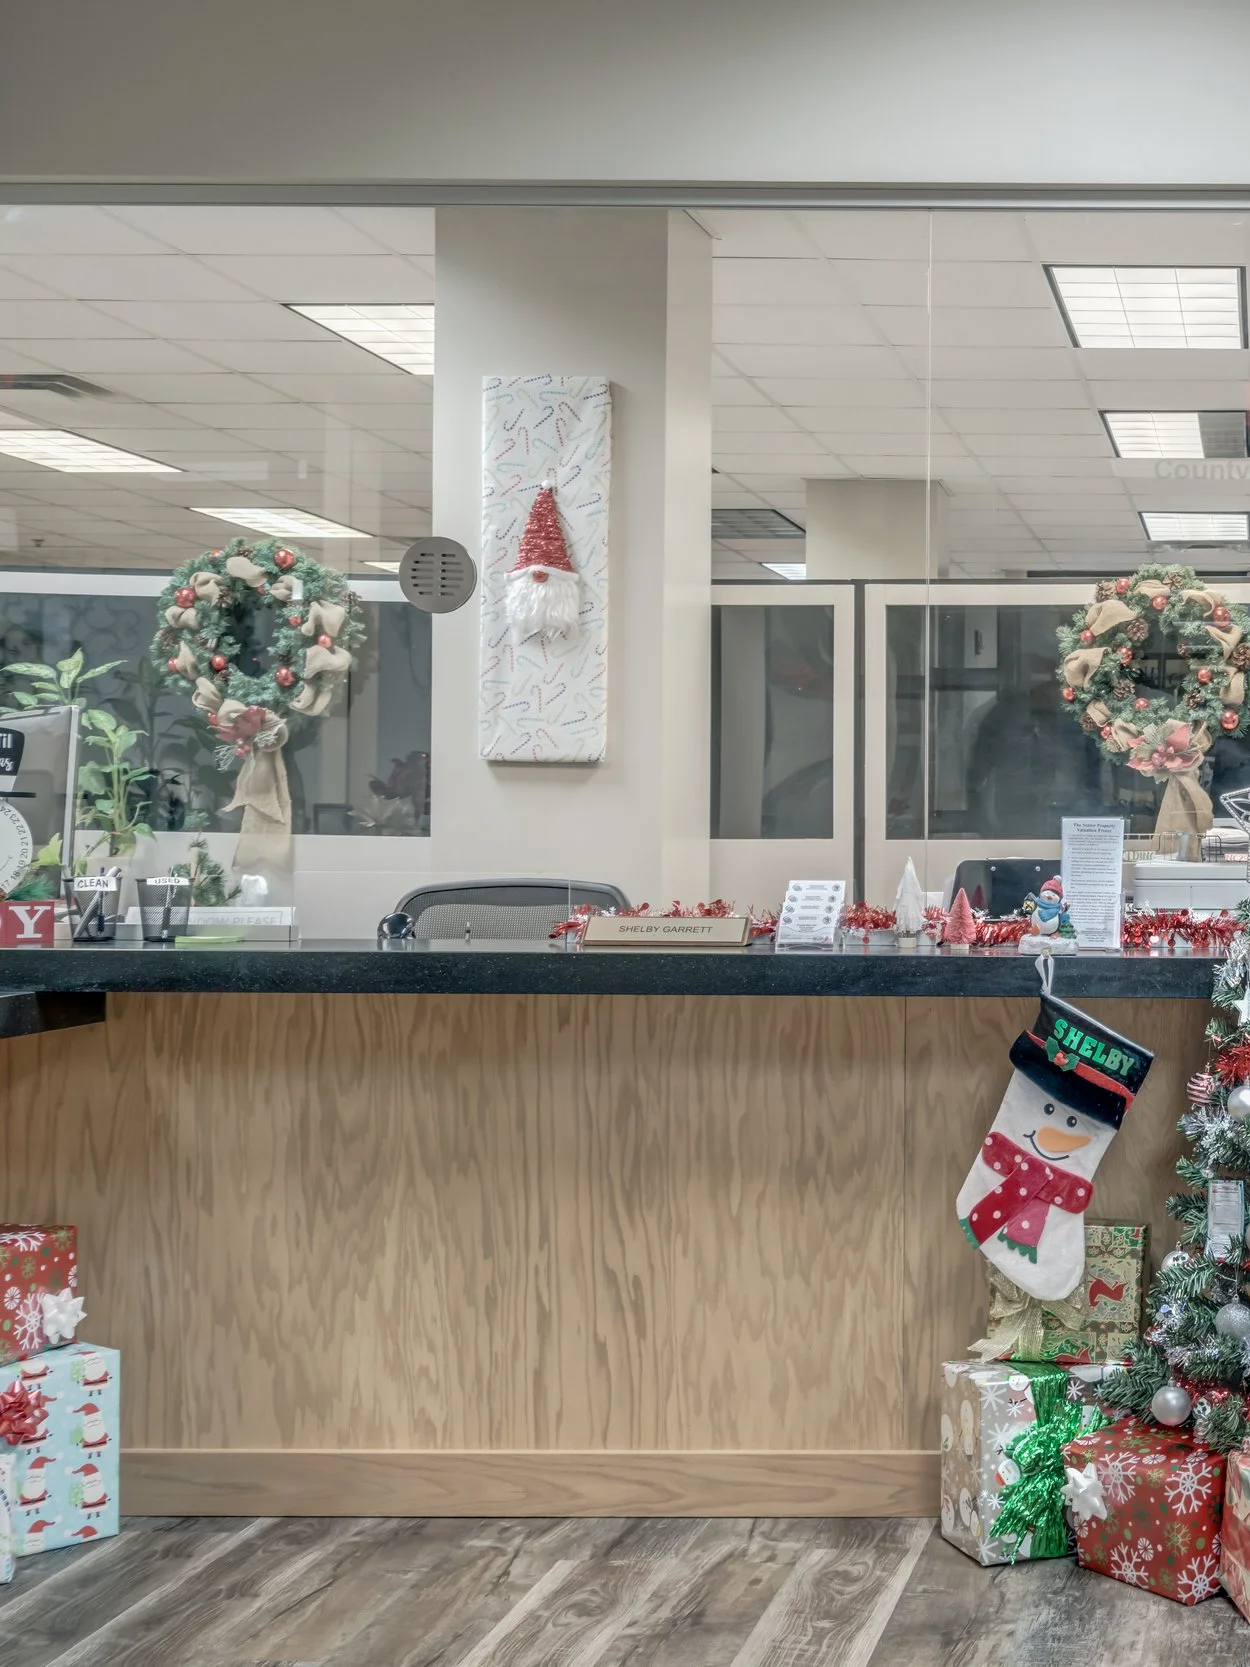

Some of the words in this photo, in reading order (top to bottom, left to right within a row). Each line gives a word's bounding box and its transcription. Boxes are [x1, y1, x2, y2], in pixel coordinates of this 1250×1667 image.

[16, 823, 26, 835] 22
[20, 836, 29, 847] 21
[20, 848, 28, 859] 20
[17, 860, 26, 870] 19
[10, 870, 20, 880] 18
[1, 879, 10, 889] 17
[77, 879, 109, 889] CLEAN
[154, 877, 180, 885] USED
[618, 925, 661, 934] SHELBY
[663, 925, 713, 934] GARRETT
[1053, 1019, 1135, 1076] SHELBY
